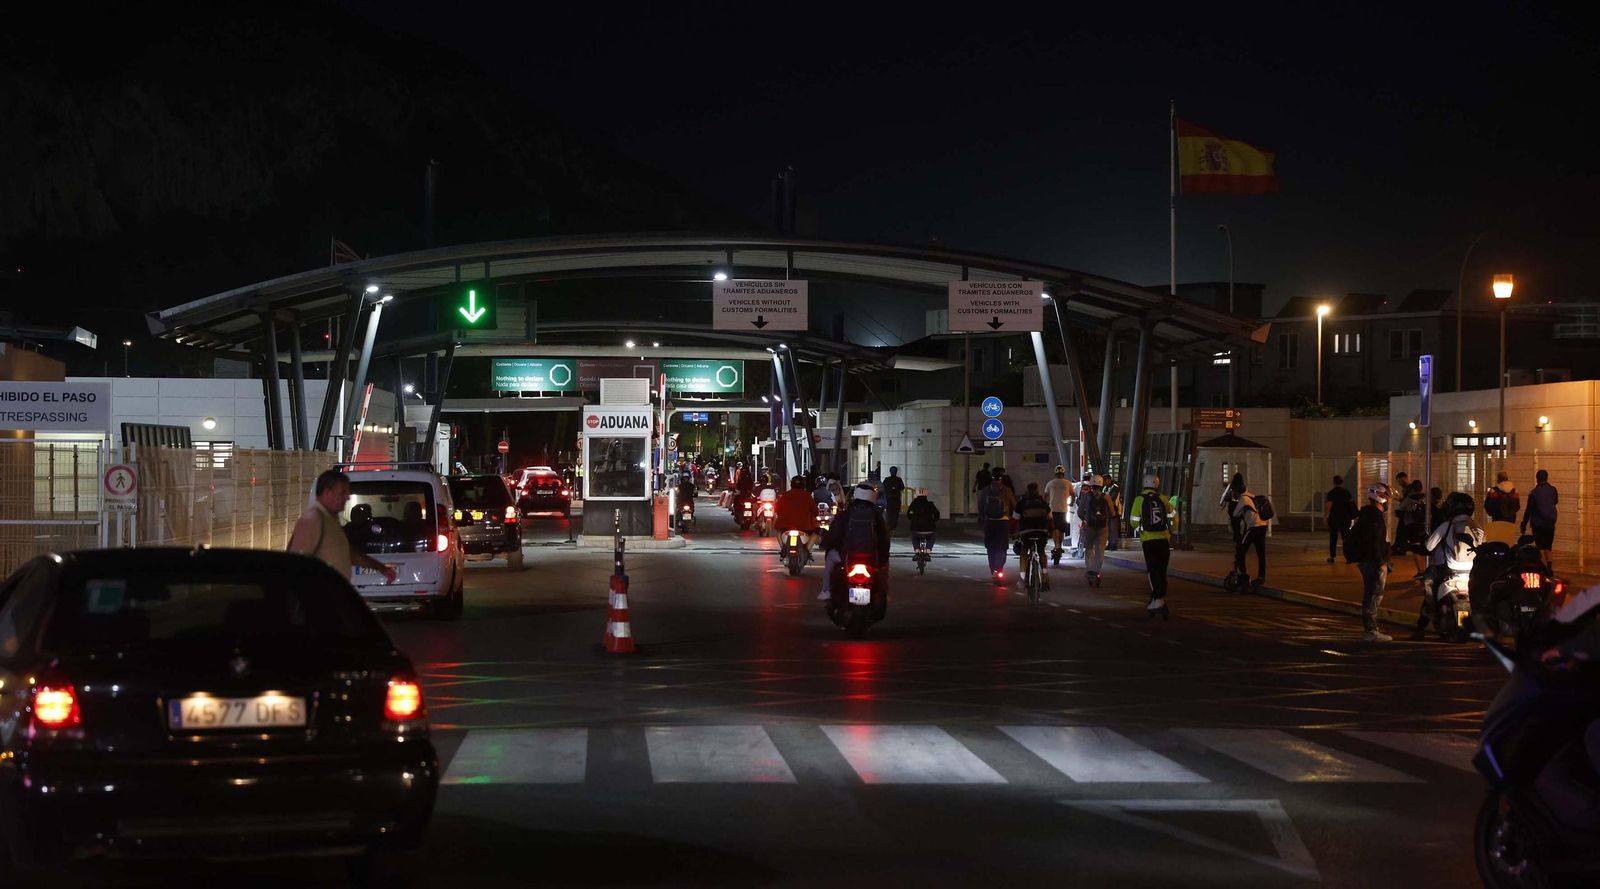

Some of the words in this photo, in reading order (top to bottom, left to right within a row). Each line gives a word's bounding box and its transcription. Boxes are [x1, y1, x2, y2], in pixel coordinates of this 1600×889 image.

[43, 392, 59, 402] EL
[62, 392, 97, 403] PASO
[0, 411, 88, 422] TRESPASSING
[600, 415, 649, 429] ADUANA
[186, 701, 247, 724] 4577
[256, 700, 300, 723] DFS
